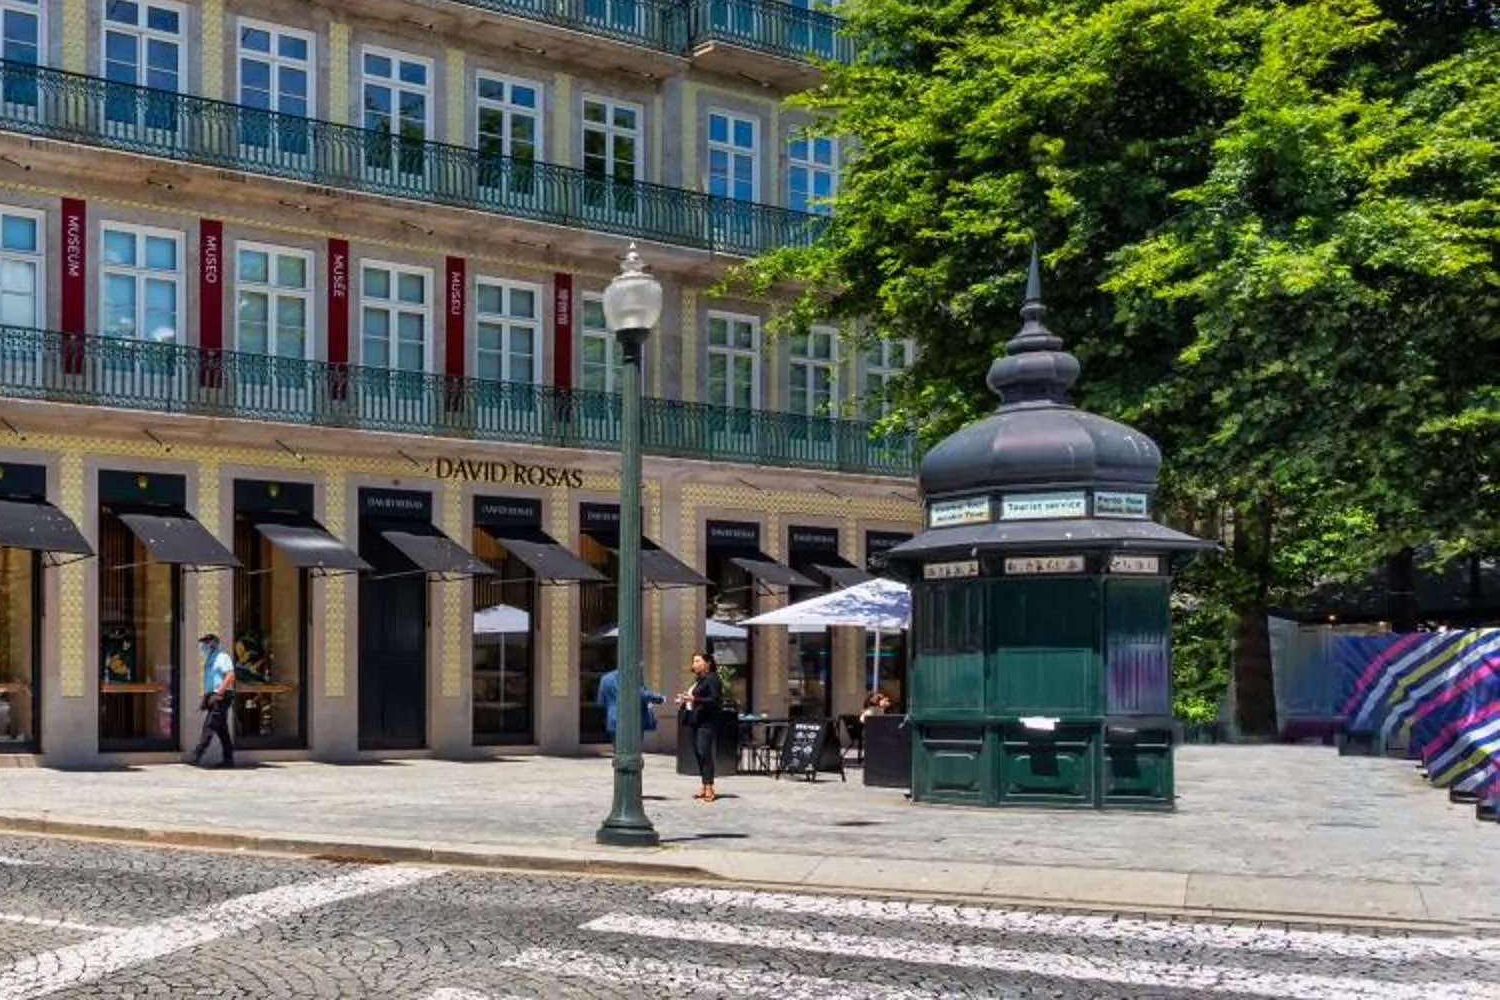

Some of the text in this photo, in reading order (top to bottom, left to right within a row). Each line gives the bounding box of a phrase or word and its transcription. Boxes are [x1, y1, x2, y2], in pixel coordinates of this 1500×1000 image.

[67, 214, 81, 277] MUSEUM
[205, 235, 217, 284] MUSEO
[451, 271, 461, 316] MUSEU
[435, 456, 584, 489] DAVID ROSAS
